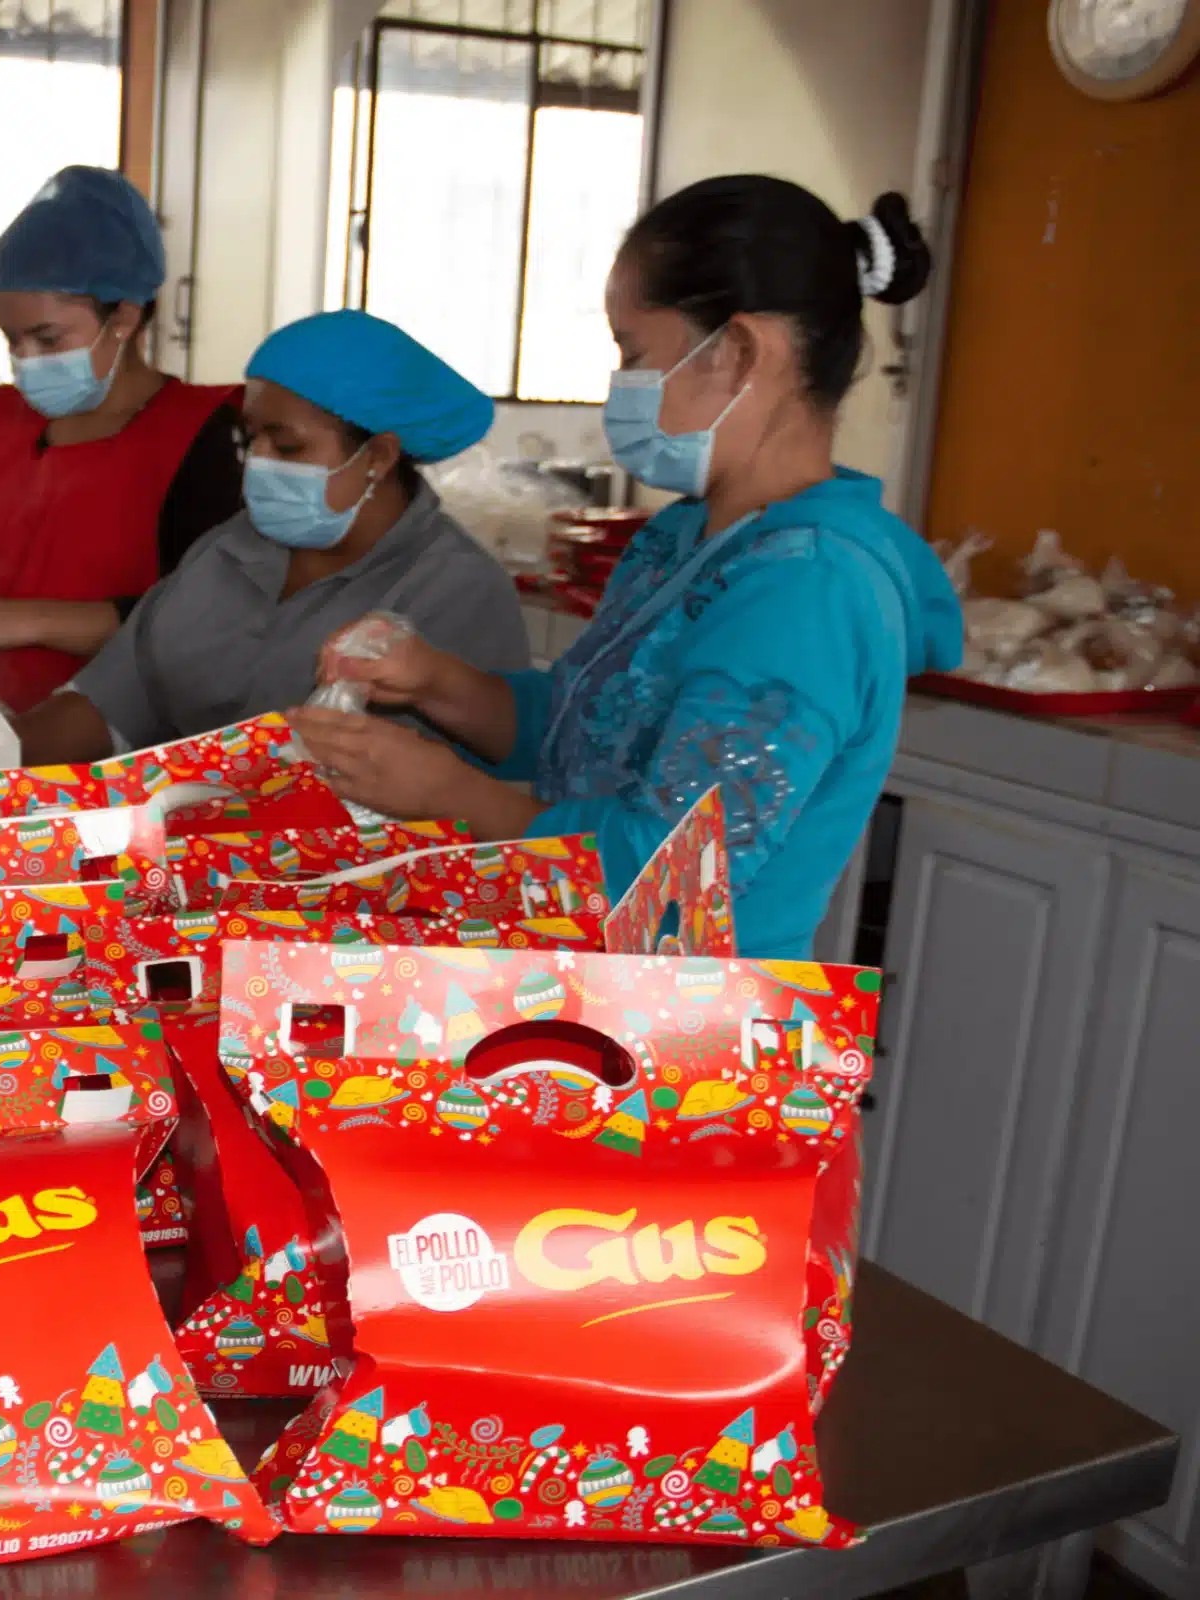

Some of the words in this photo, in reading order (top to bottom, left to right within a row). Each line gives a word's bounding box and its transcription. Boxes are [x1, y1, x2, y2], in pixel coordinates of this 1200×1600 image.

[396, 1238, 418, 1266] EL
[416, 1228, 480, 1264] POLLO
[514, 1207, 767, 1290] Gus
[440, 1258, 503, 1292] POLLO
